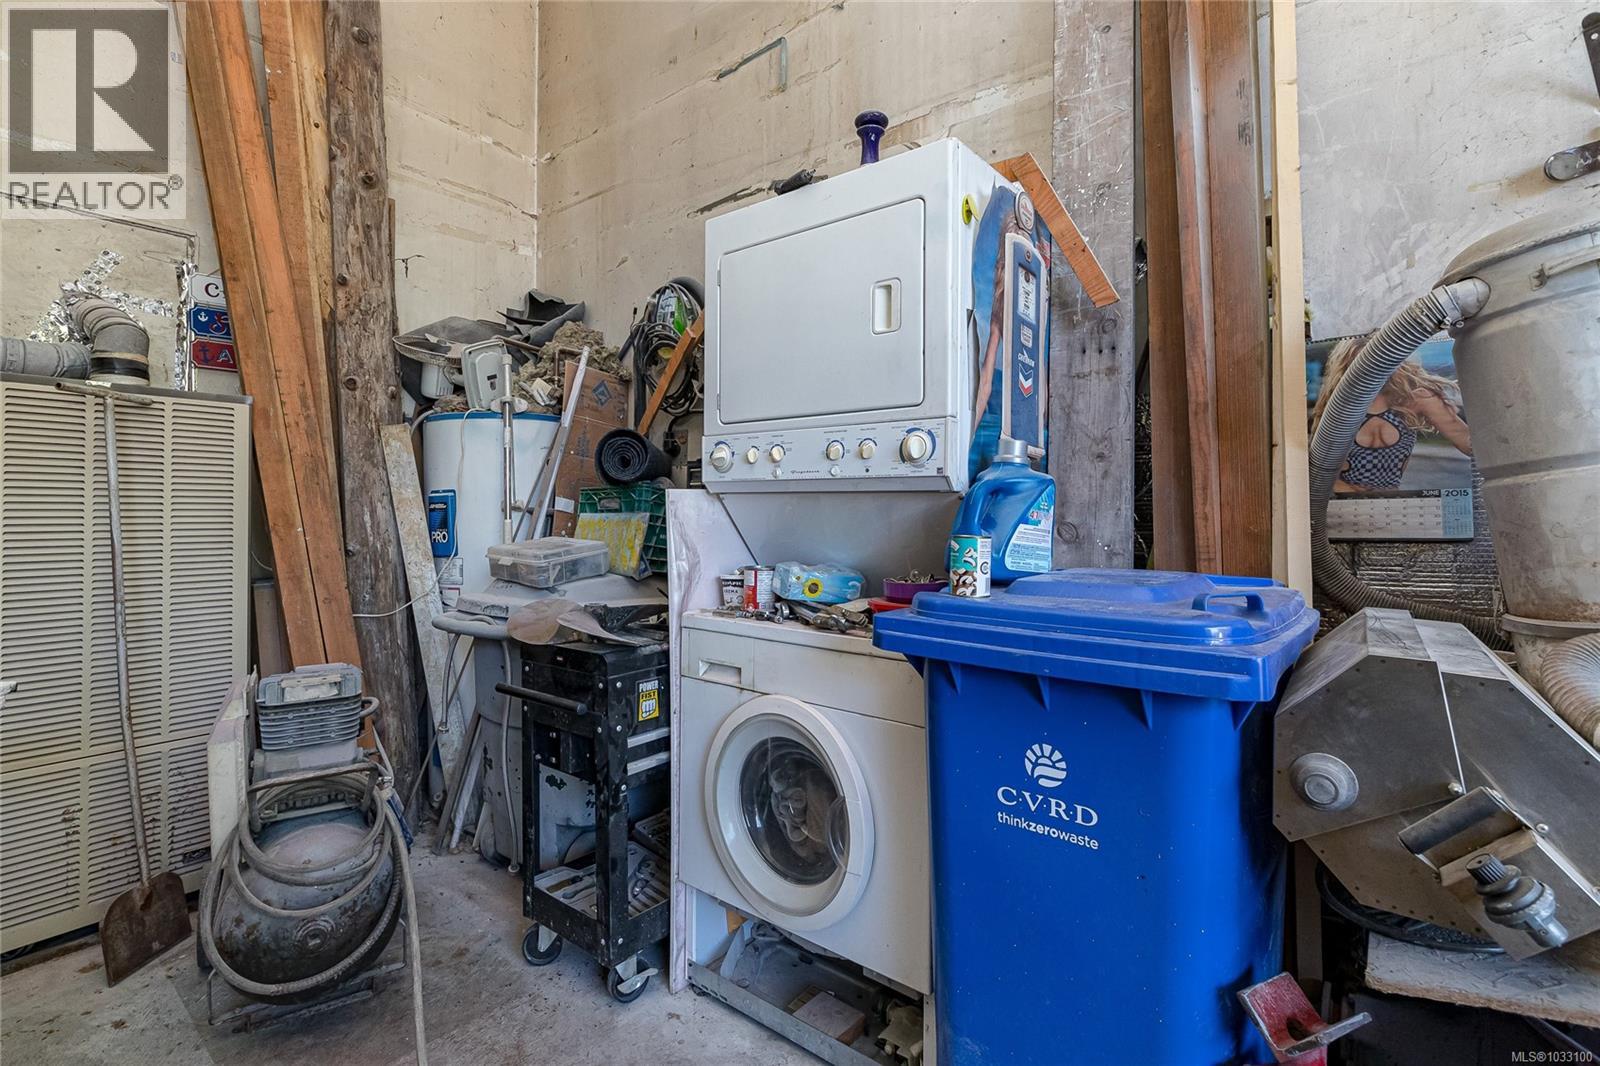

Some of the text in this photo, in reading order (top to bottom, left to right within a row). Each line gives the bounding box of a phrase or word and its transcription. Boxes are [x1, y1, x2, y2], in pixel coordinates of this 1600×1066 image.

[1444, 489, 1469, 497] 2015
[431, 531, 449, 543] PRO
[639, 680, 659, 692] POWER
[641, 691, 656, 699] FIST
[997, 811, 1100, 850] thinkzerowaste
